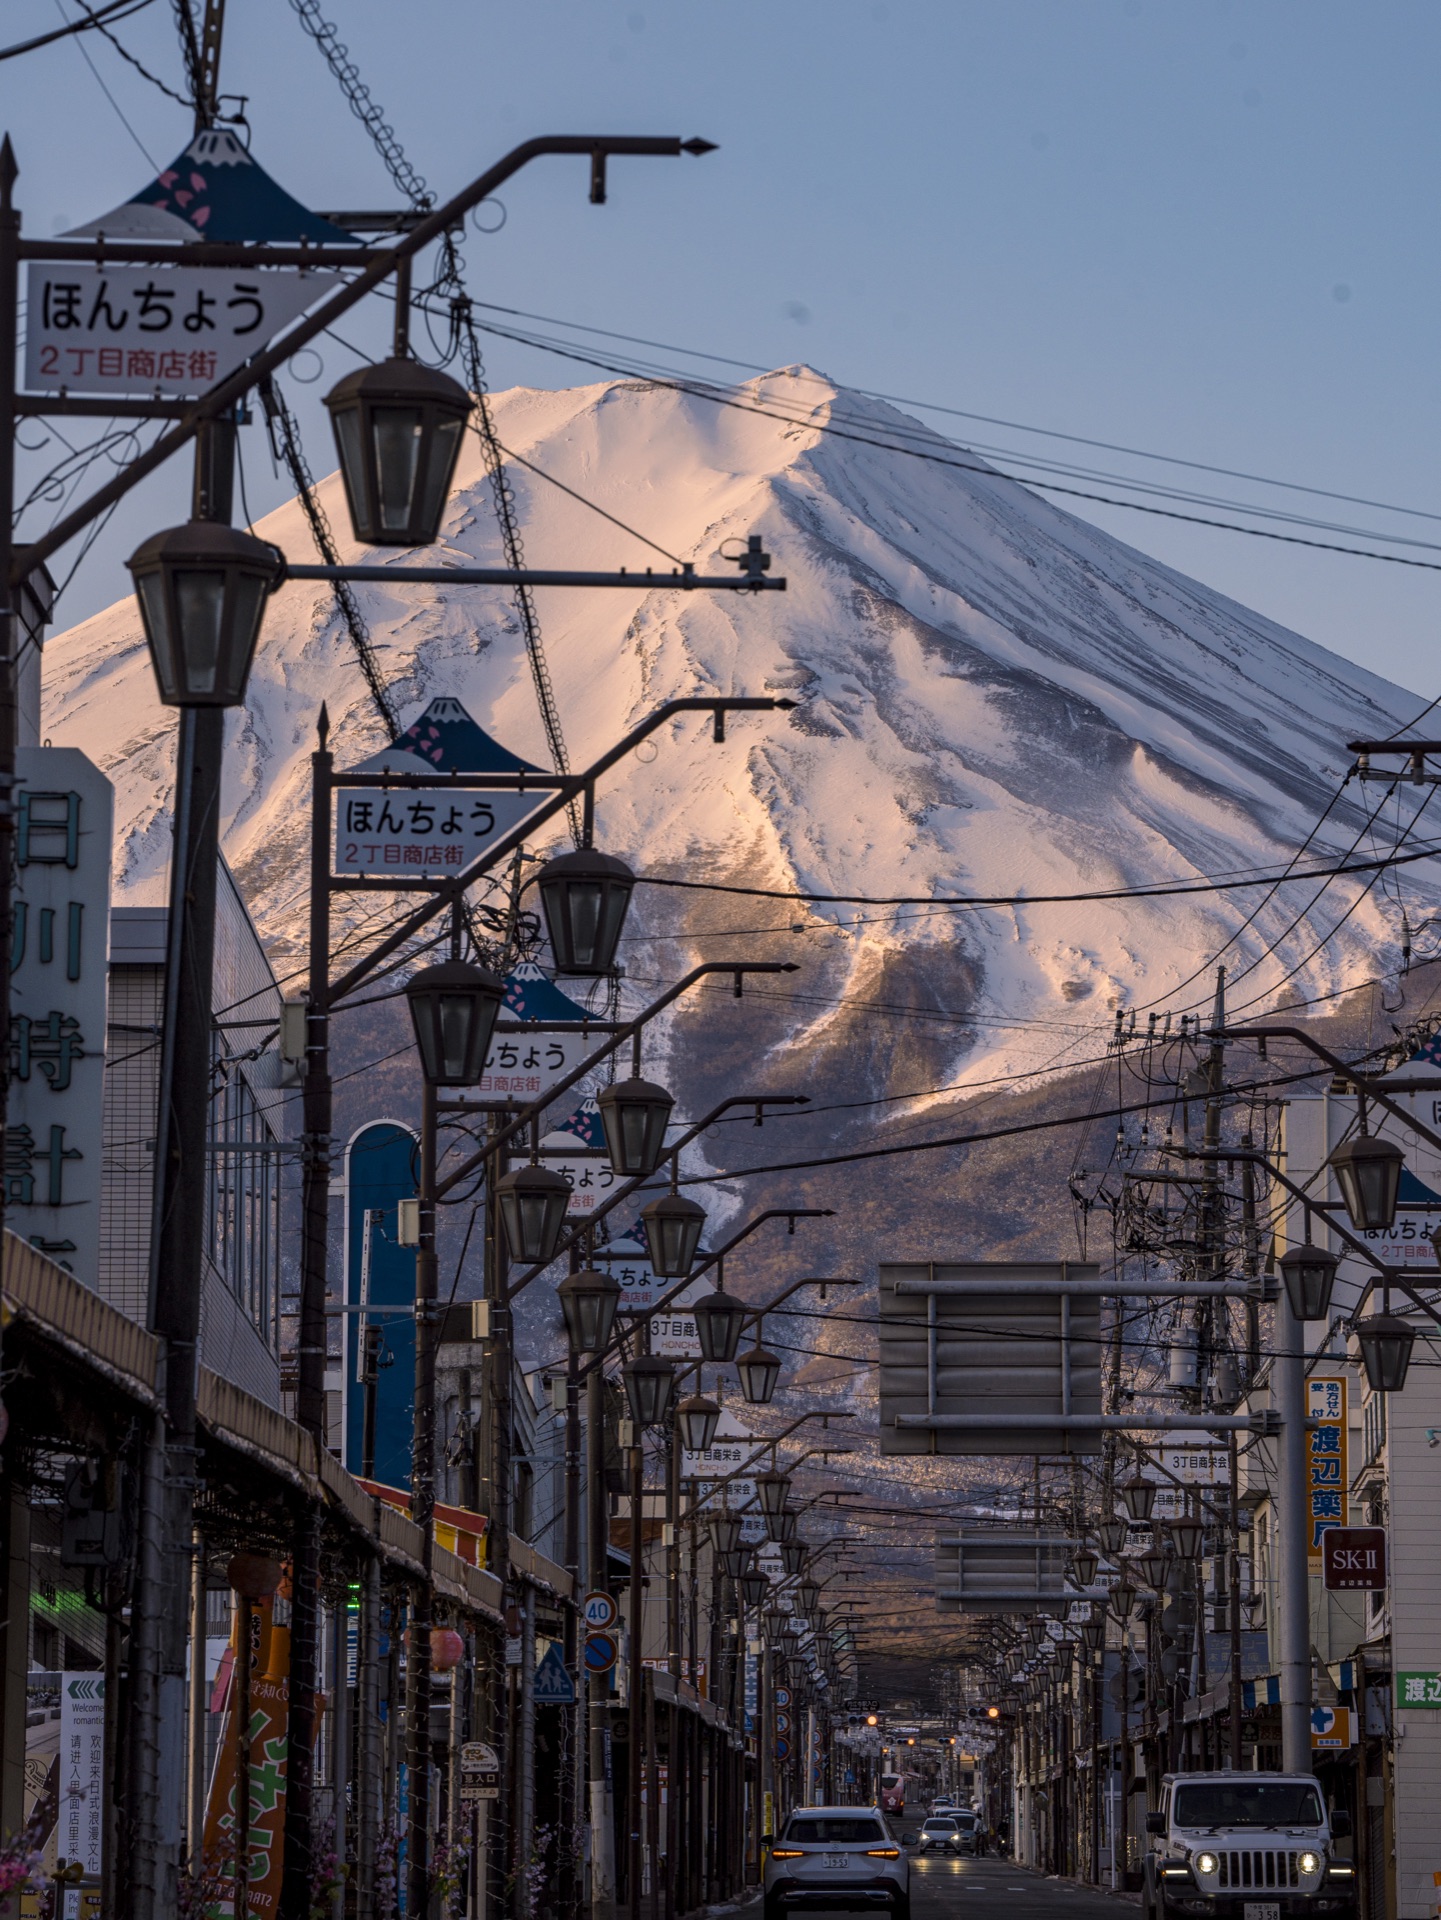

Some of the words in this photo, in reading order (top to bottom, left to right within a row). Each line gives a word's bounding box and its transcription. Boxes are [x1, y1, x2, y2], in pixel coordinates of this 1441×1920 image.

[42, 281, 264, 335] ほんちょう
[40, 345, 218, 381] 2丁目商店街
[346, 799, 495, 836] ほんちょう
[345, 843, 463, 866] 2丁目商店街
[449, 1076, 541, 1092] 目商店街
[651, 1320, 699, 1337] 3丁目商
[1326, 1383, 1339, 1417] 処方せん
[1173, 1456, 1227, 1469] 3丁目商栄会
[1332, 1549, 1378, 1569] SK-II
[588, 1602, 608, 1619] 40
[72, 1703, 104, 1713] Welcome
[88, 1735, 102, 1872] 欢迎来日式浪漫文化
